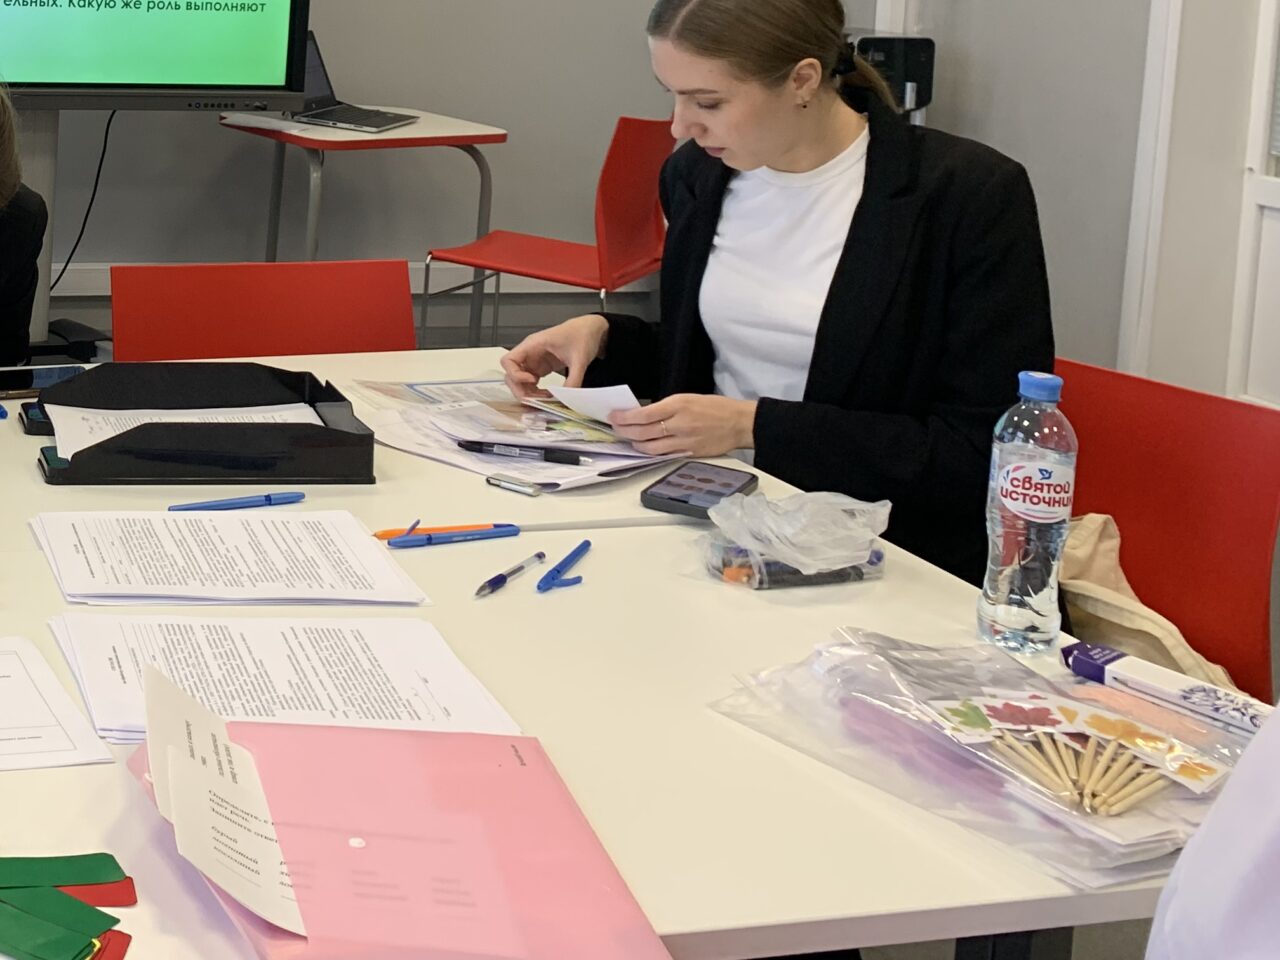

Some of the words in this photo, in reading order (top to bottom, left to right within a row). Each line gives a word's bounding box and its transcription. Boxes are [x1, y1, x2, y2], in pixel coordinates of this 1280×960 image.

[146, 0, 181, 13] роль
[186, 0, 266, 13] выполняют
[1000, 486, 1072, 508] ИСТОЧНИ
